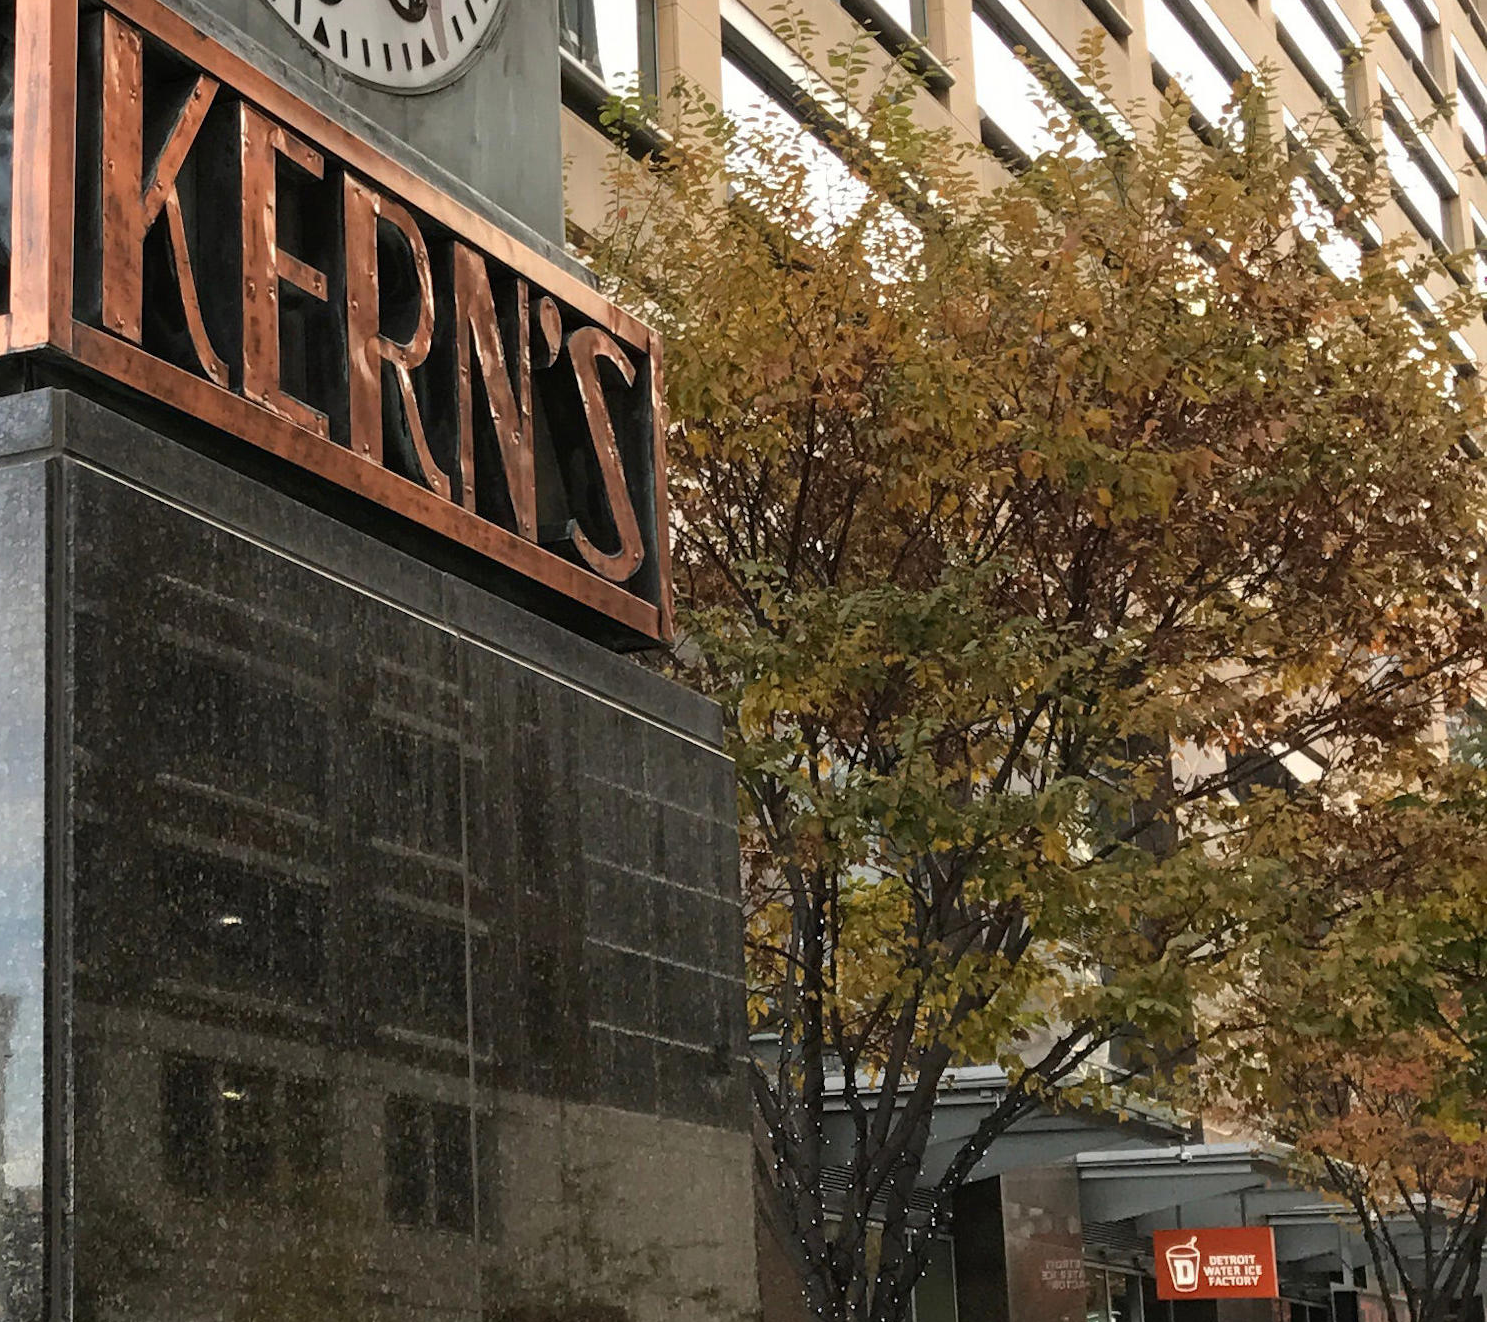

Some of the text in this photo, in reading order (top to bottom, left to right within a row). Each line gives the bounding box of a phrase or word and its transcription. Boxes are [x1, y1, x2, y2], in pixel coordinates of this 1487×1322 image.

[99, 7, 645, 584] KERN'S
[1209, 1254, 1256, 1266] DETROIT
[1174, 1259, 1195, 1285] D
[1203, 1264, 1263, 1276] WATER ICE
[1208, 1275, 1260, 1287] FACTORY
